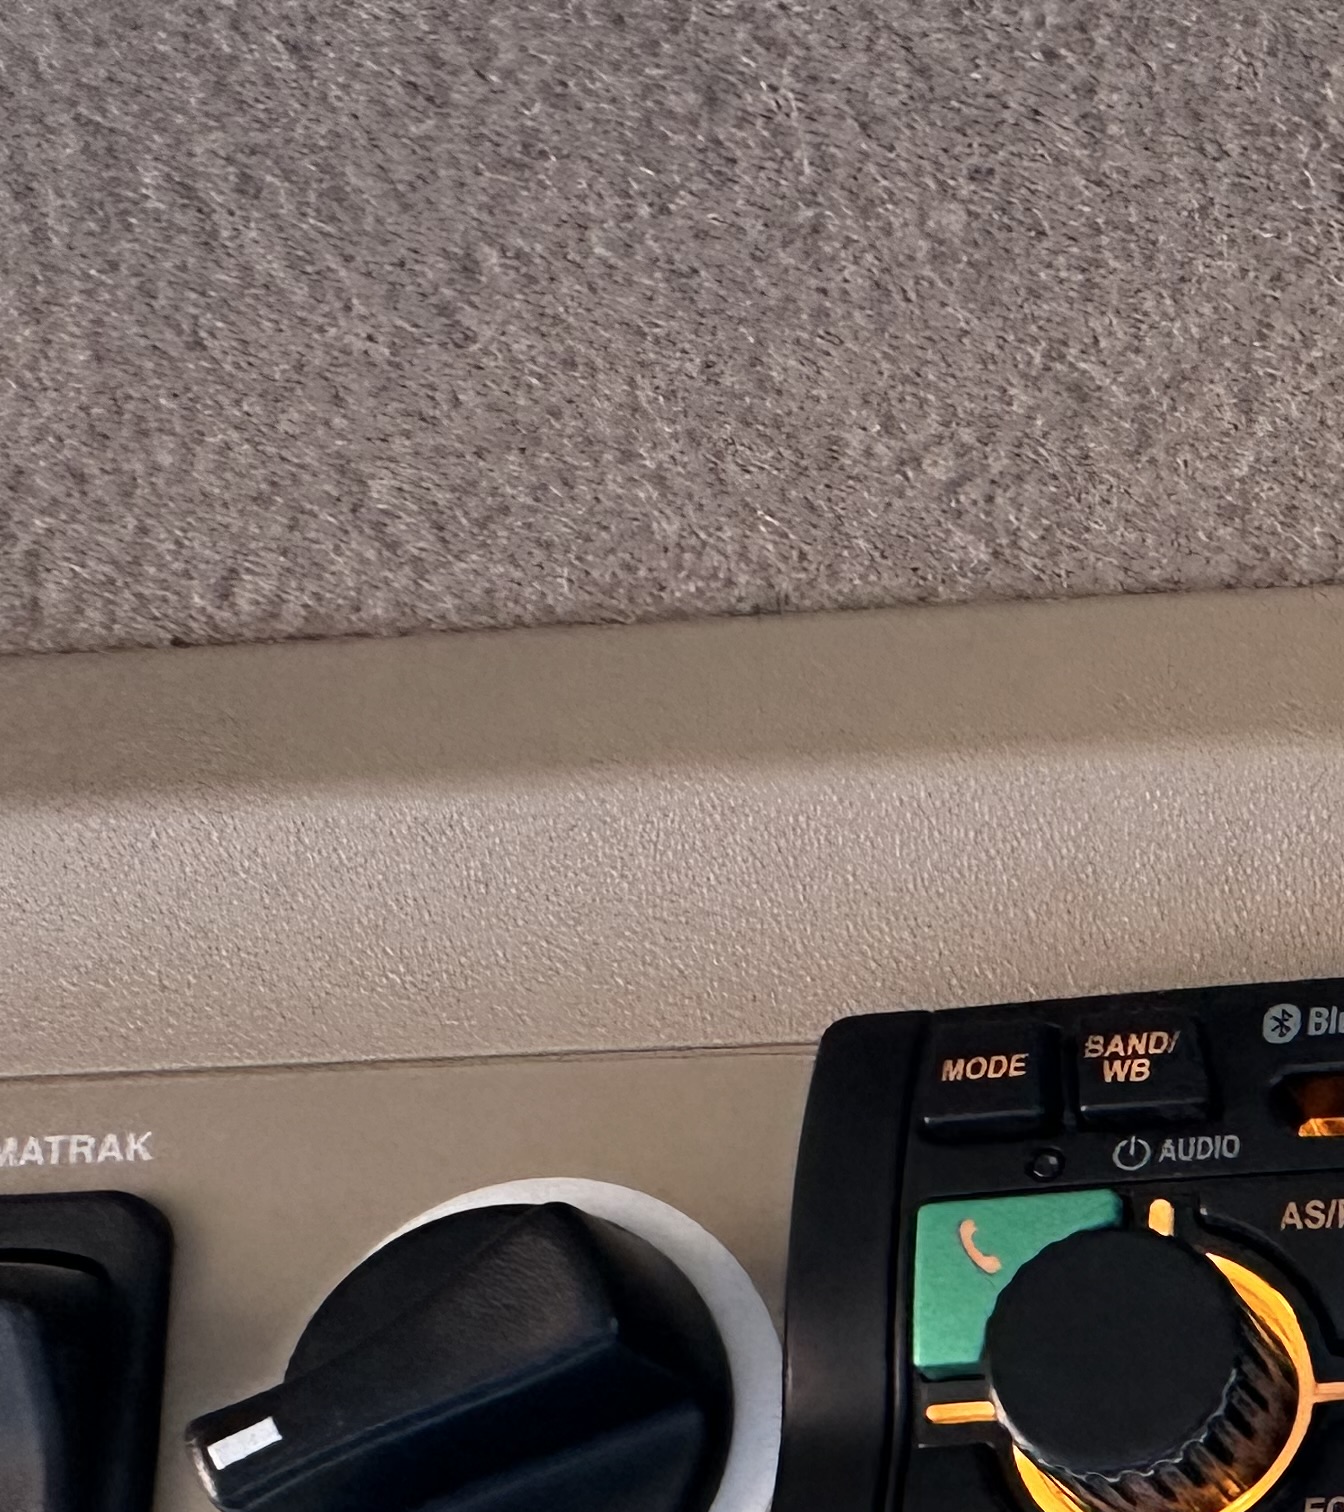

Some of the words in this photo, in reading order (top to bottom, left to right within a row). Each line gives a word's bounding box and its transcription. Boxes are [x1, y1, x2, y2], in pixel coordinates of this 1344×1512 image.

[1083, 1030, 1182, 1060] BAND/
[941, 1053, 1028, 1082] MODE
[1102, 1058, 1151, 1084] WB
[1158, 1134, 1241, 1164] AUDIO
